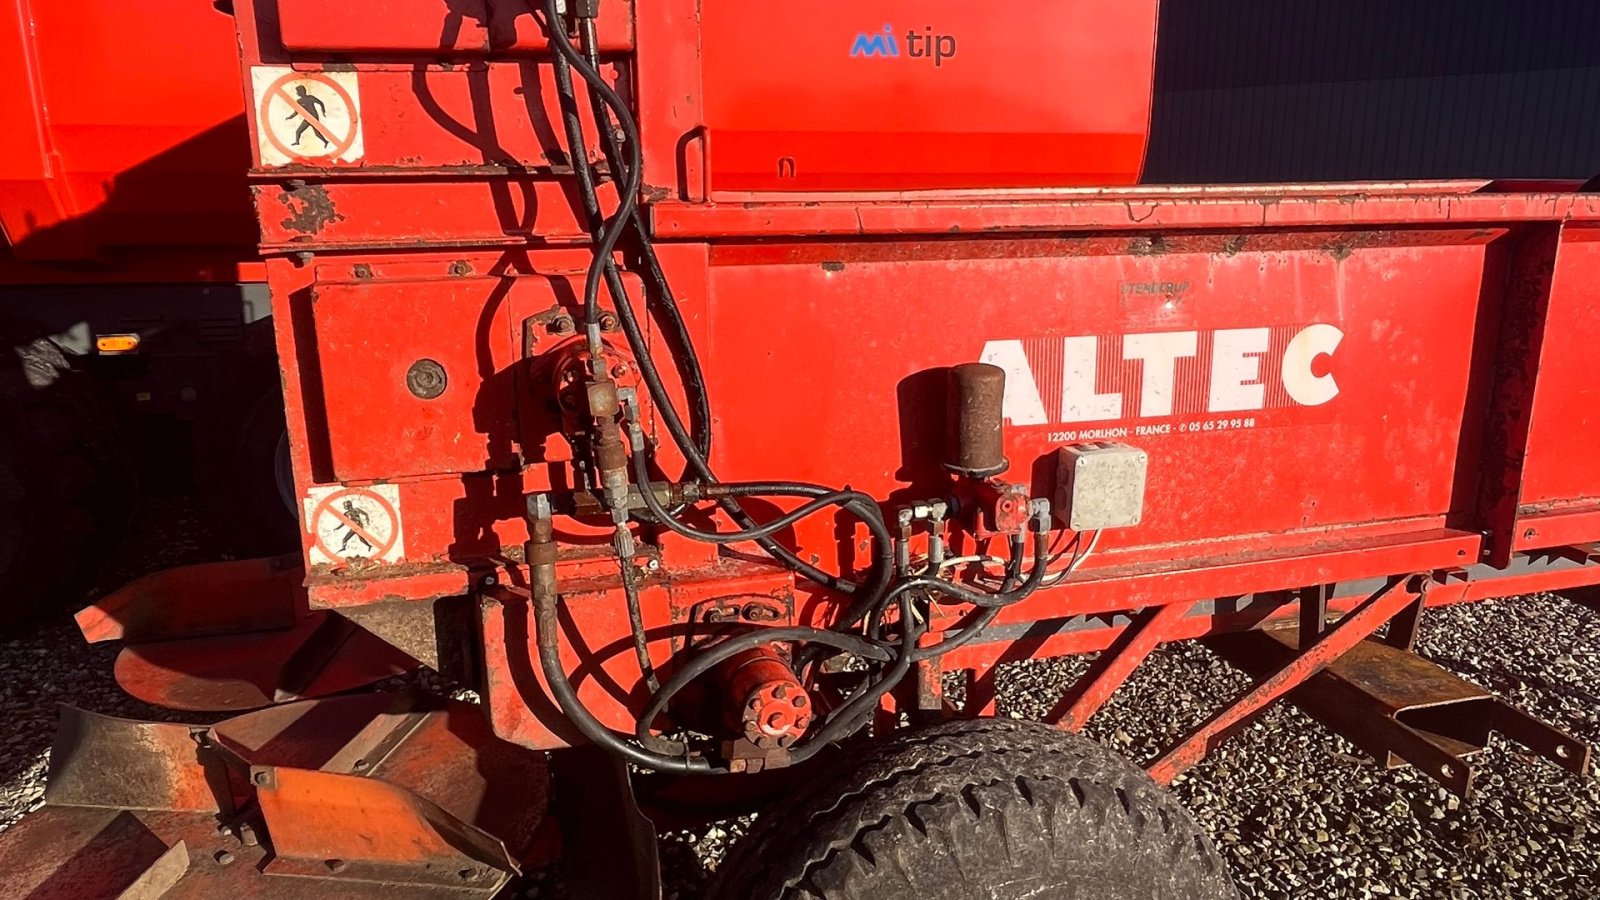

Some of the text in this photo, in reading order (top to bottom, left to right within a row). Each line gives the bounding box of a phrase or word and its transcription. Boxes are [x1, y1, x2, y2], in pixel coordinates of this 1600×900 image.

[849, 23, 956, 67] mi tip
[978, 323, 1345, 426] ALTEC
[1047, 431, 1077, 443] 12200
[1078, 427, 1128, 441] MORLHON
[1135, 424, 1171, 436] FRANCE
[1189, 421, 1201, 432] 05
[1202, 420, 1215, 431] 65
[1216, 419, 1229, 430] 29
[1230, 418, 1242, 429] 95
[1243, 417, 1256, 428] 88
